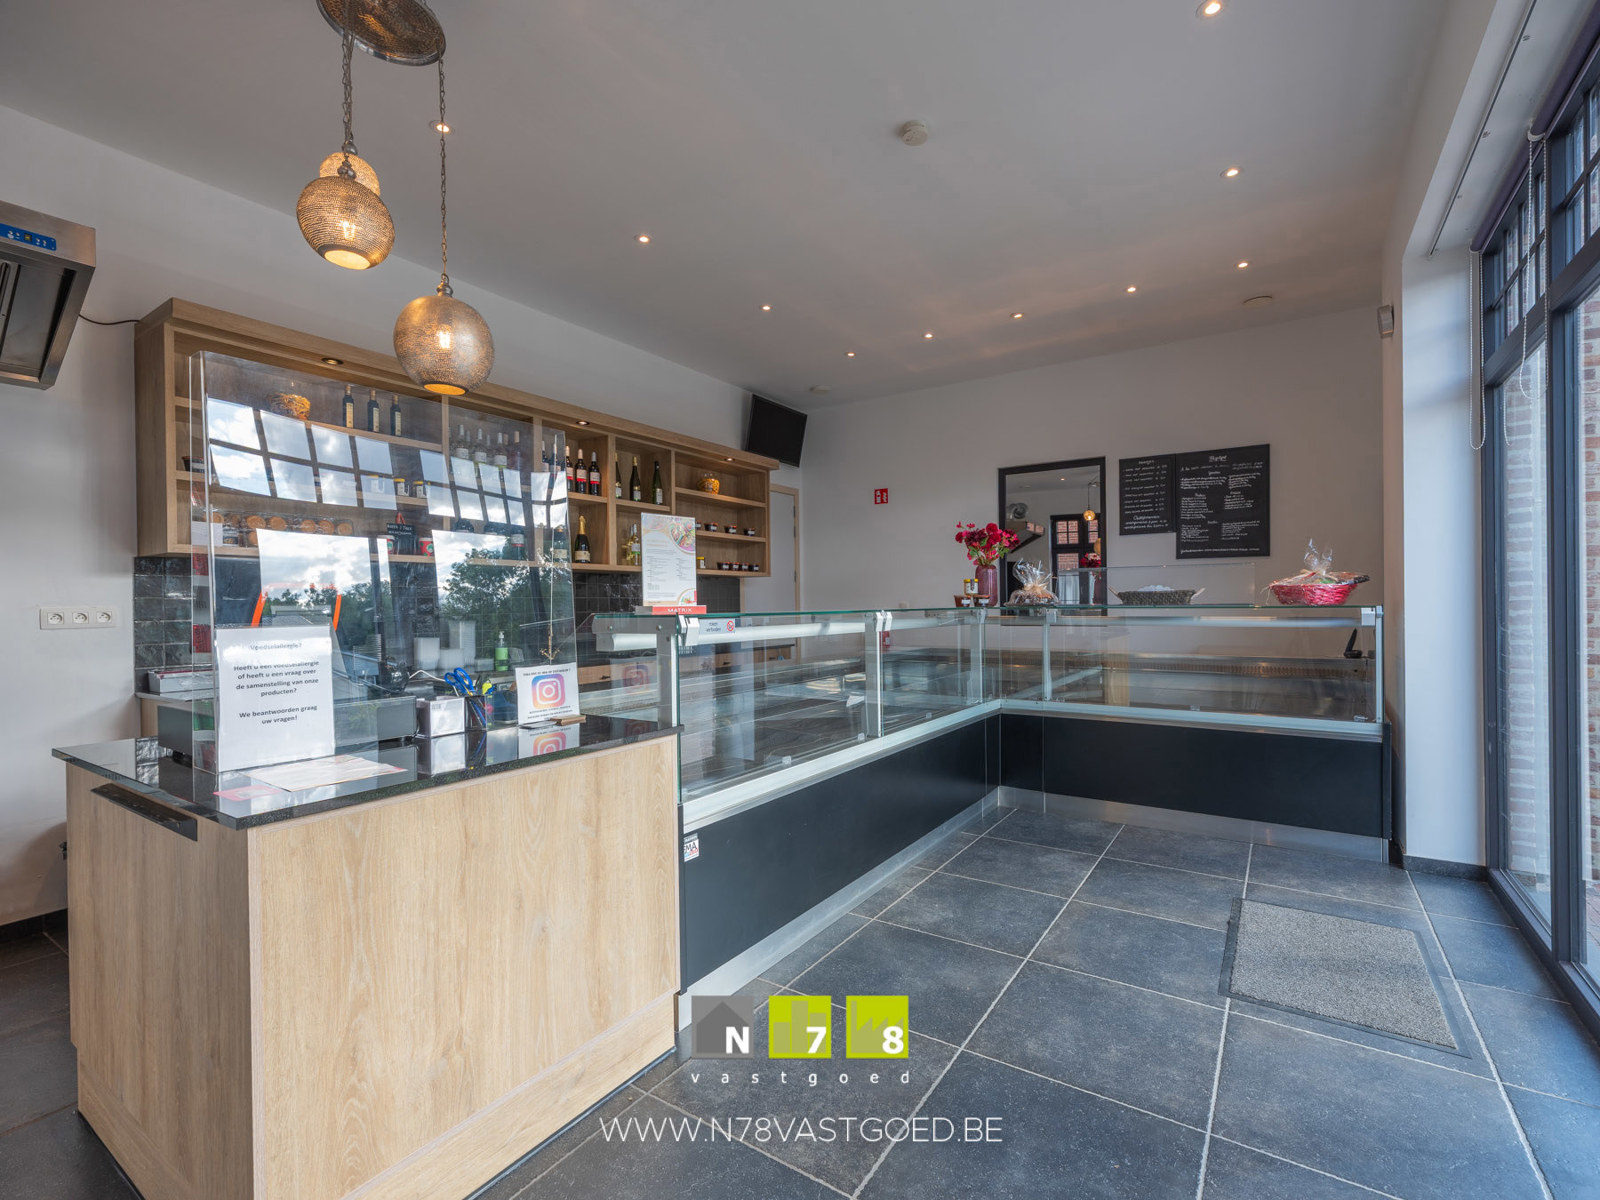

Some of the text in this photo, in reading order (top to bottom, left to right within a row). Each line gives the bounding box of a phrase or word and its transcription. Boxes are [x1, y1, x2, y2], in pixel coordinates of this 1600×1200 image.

[246, 681, 291, 690] samenstelling
[260, 688, 297, 697] producten?
[252, 707, 300, 717] beantwoorden
[300, 705, 318, 713] graag
[273, 715, 298, 723] vragen!
